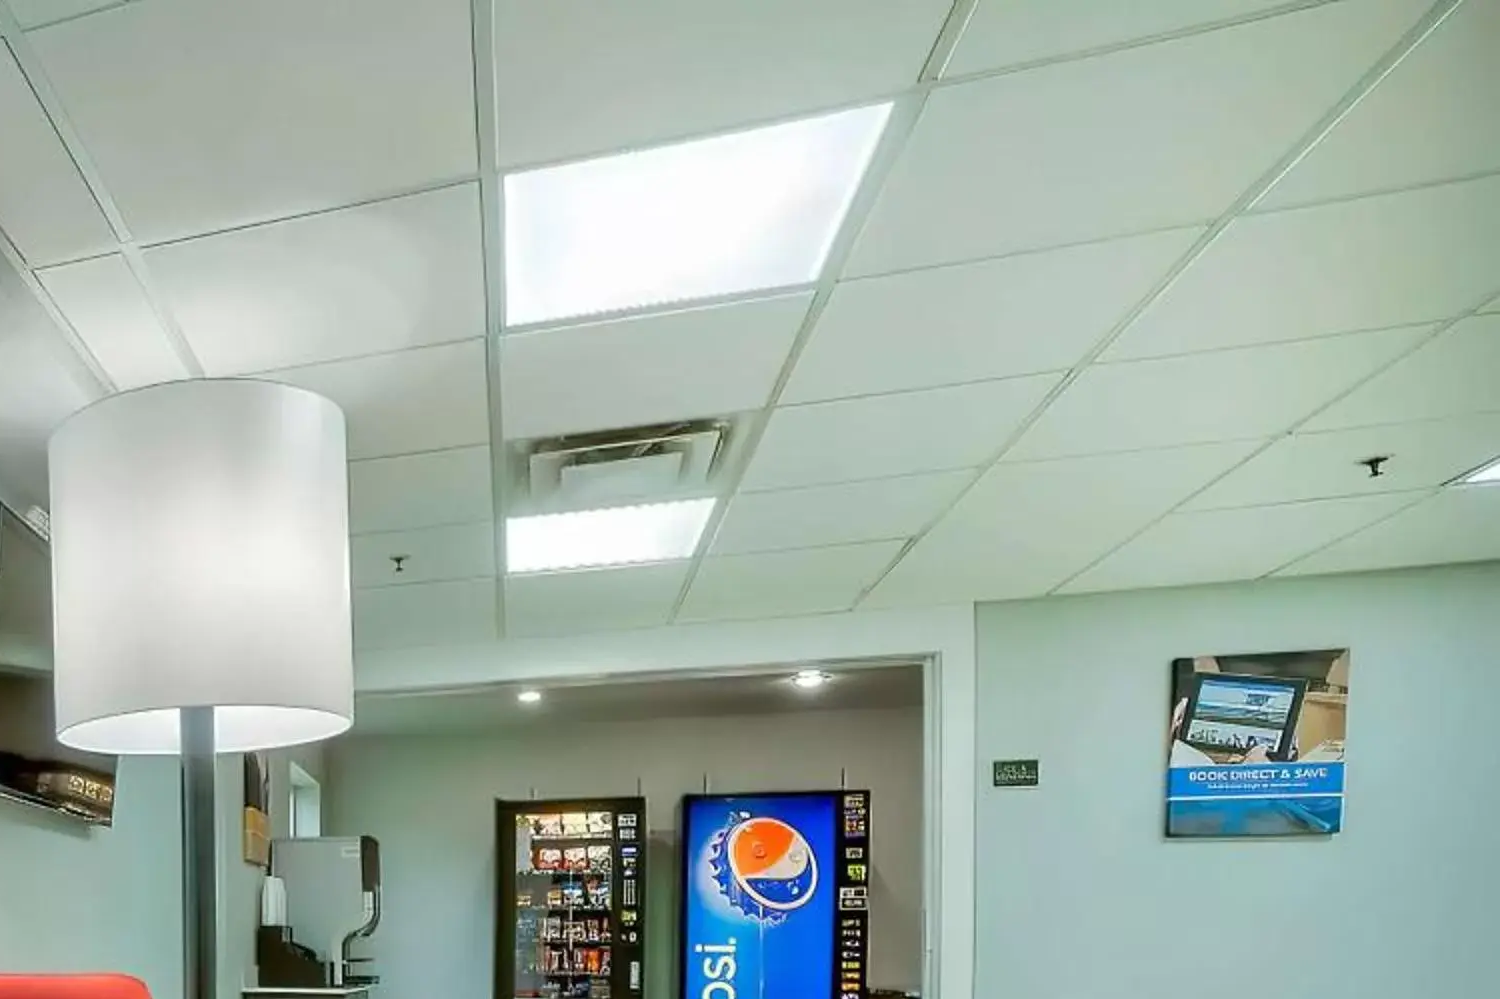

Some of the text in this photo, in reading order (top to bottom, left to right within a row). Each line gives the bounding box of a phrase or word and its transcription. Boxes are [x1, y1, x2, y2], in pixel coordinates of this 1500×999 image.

[1189, 767, 1329, 782] BOOK DIRECT & SAVE
